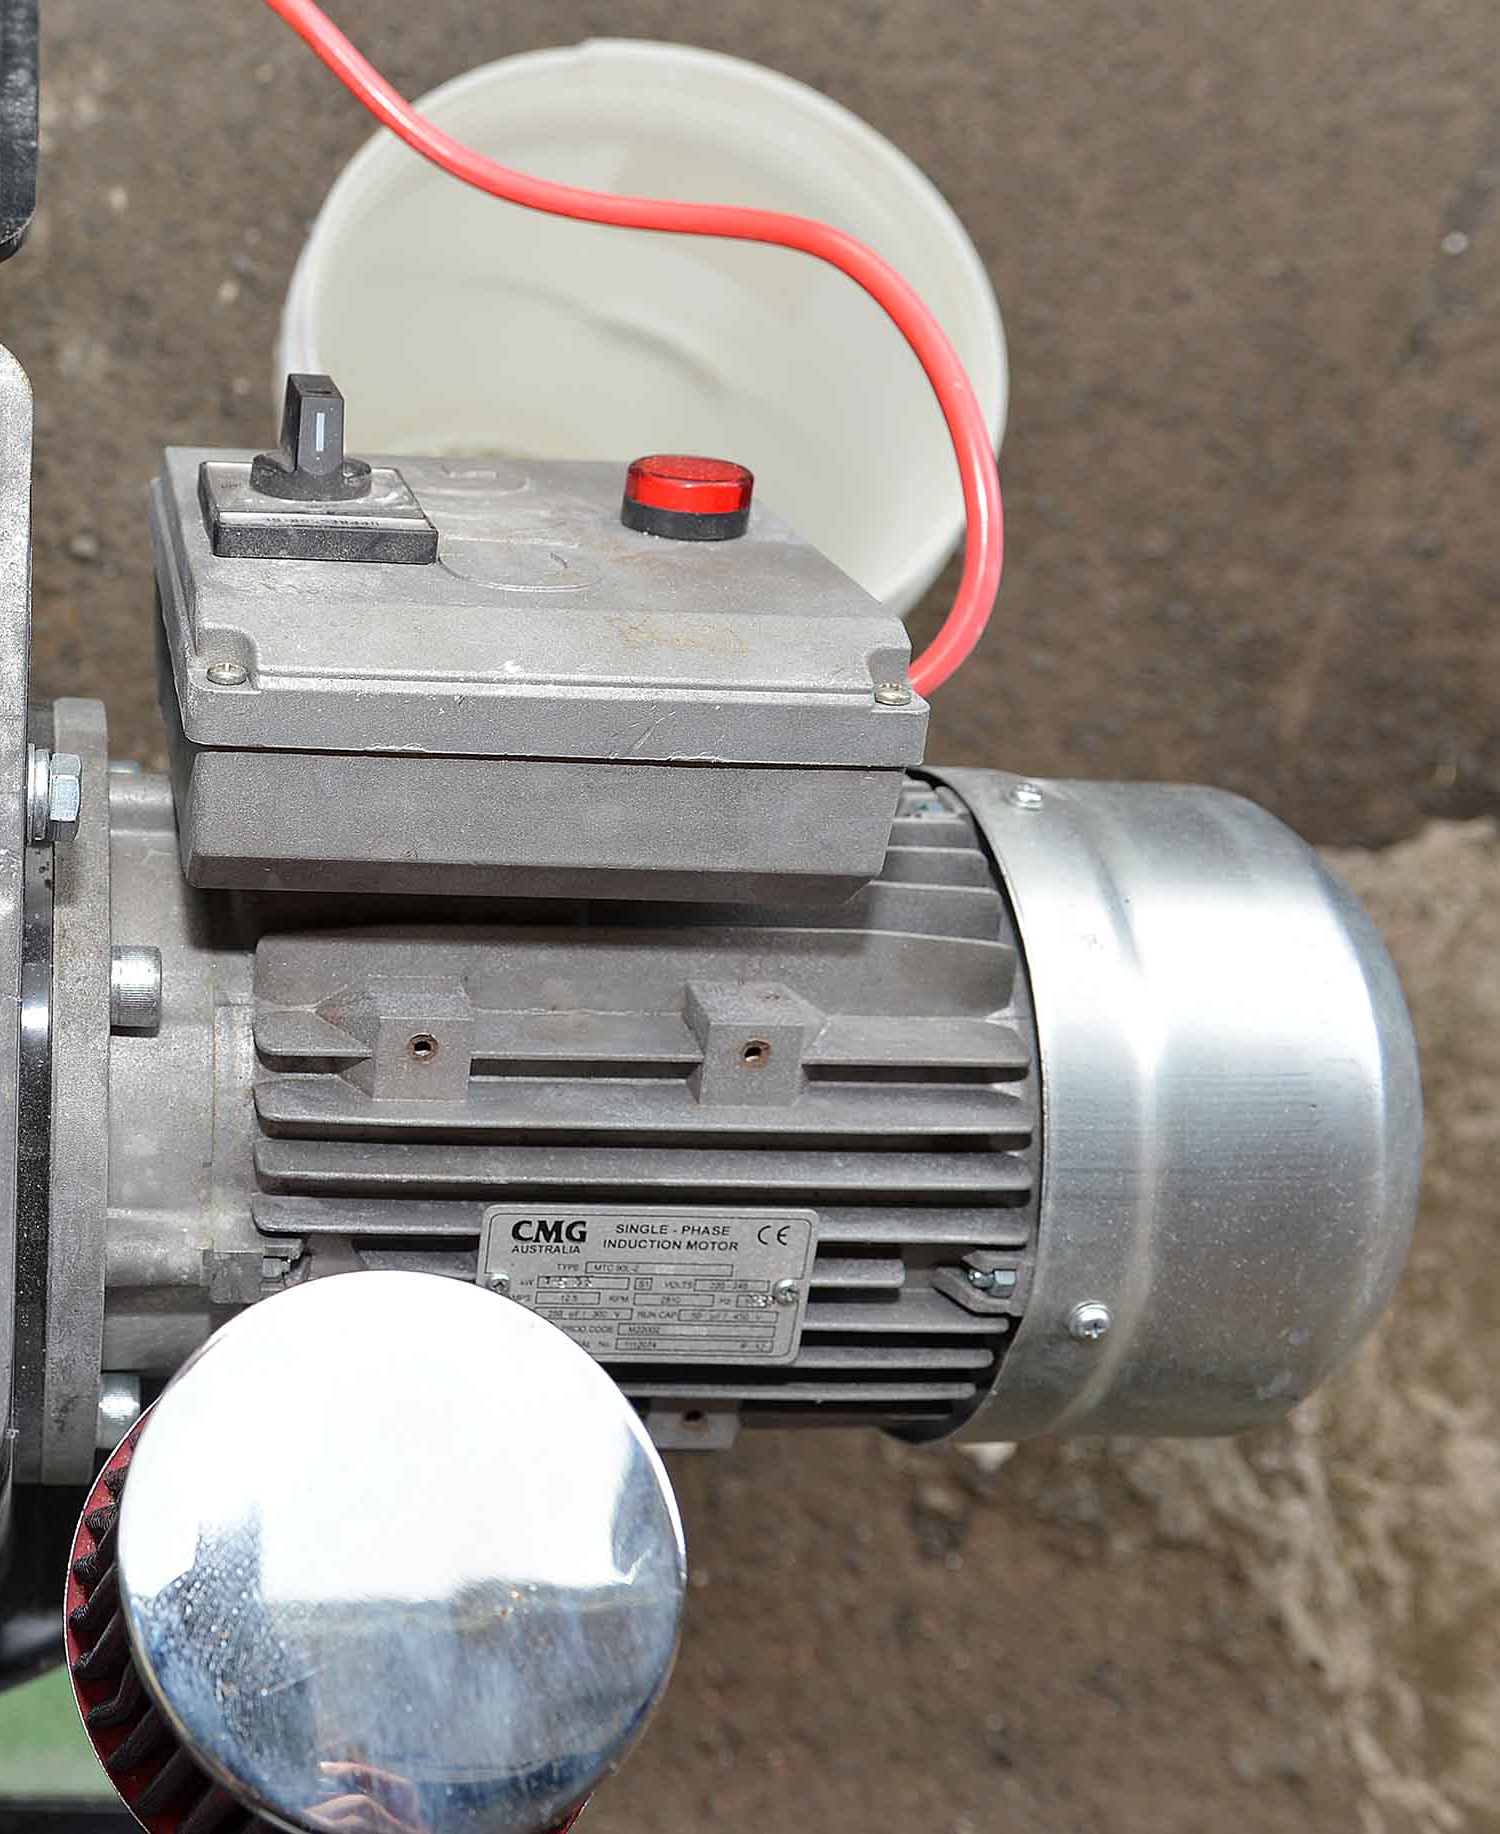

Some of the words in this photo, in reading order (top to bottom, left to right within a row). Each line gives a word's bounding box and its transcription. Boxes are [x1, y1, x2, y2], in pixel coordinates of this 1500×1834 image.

[511, 1220, 587, 1243] CMG
[615, 1223, 668, 1235] SINGLE
[681, 1225, 731, 1236] PHASE
[511, 1245, 580, 1254] AUSTRALIA
[603, 1239, 681, 1250] INDUCTION
[686, 1240, 739, 1251] MOTOR
[557, 1263, 580, 1272] TYPE
[664, 1281, 693, 1290] VOLTS
[637, 1311, 657, 1319] RUN
